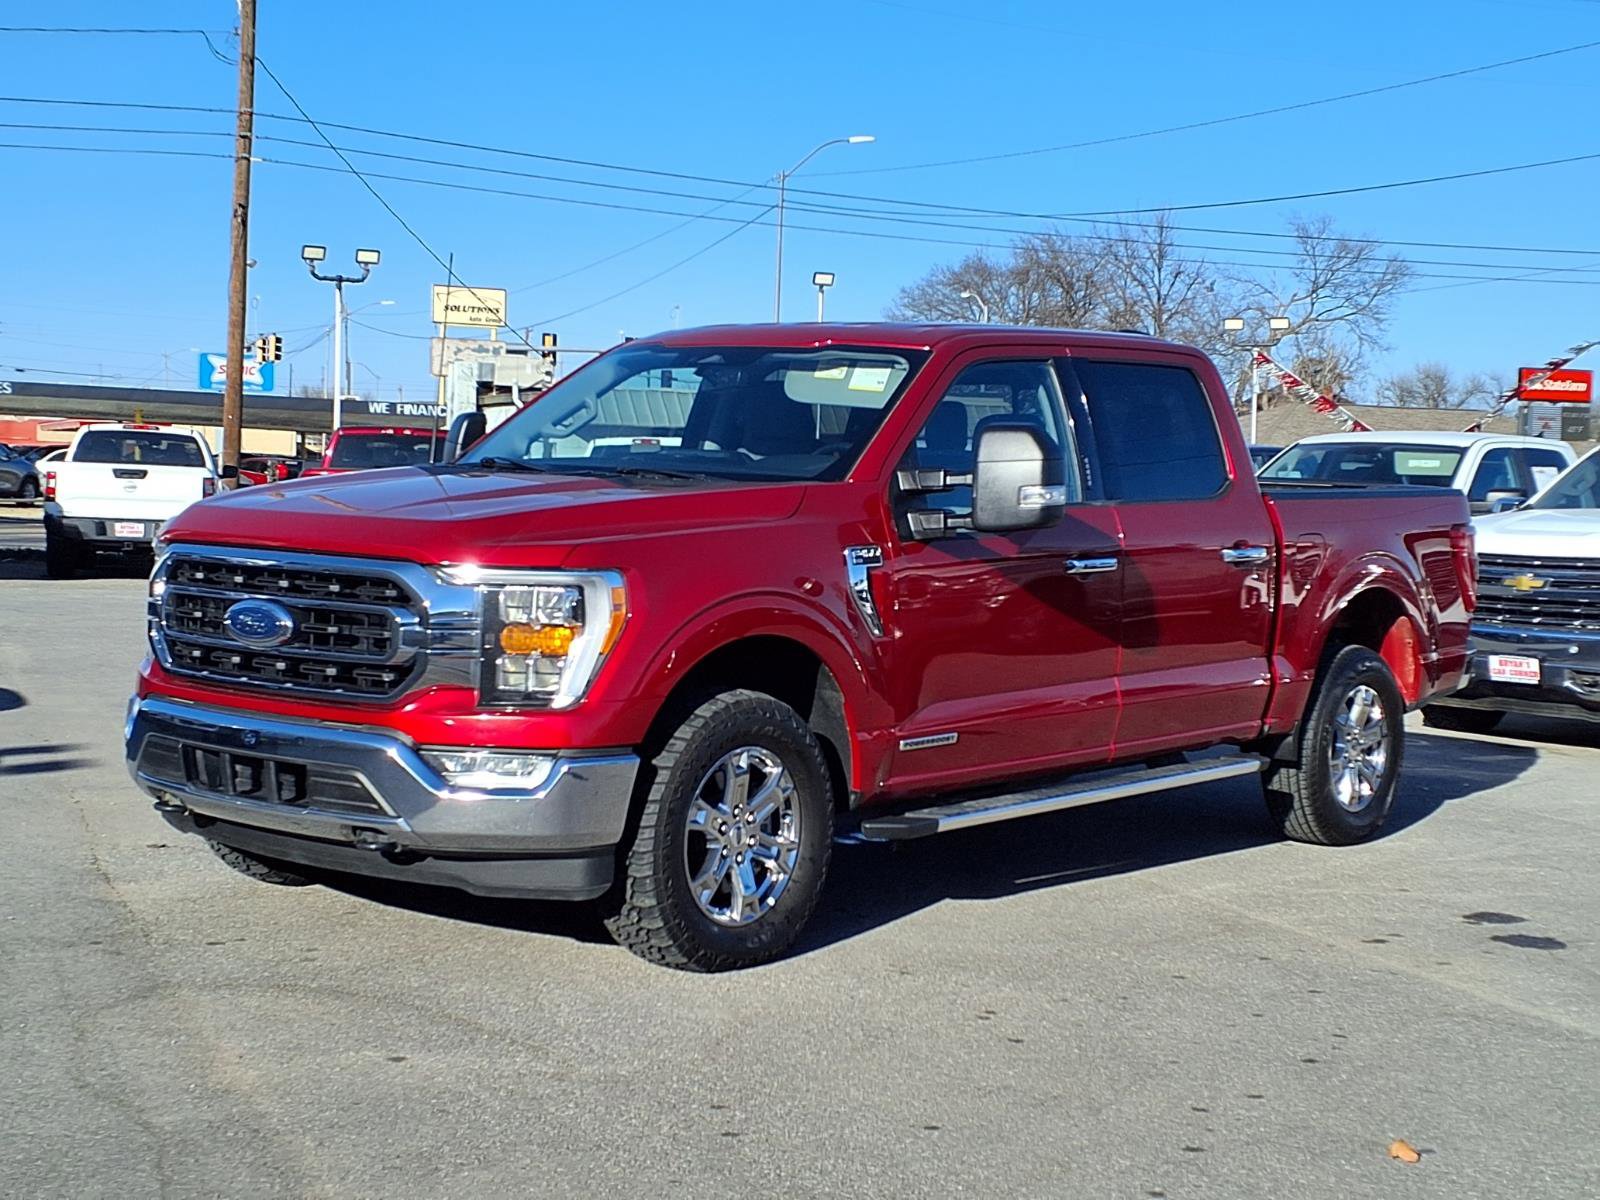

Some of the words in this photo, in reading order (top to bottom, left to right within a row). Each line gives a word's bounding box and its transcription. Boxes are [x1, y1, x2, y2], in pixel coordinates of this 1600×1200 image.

[443, 303, 501, 314] SOLUTIONS
[218, 364, 257, 376] SIC
[368, 402, 391, 414] WE
